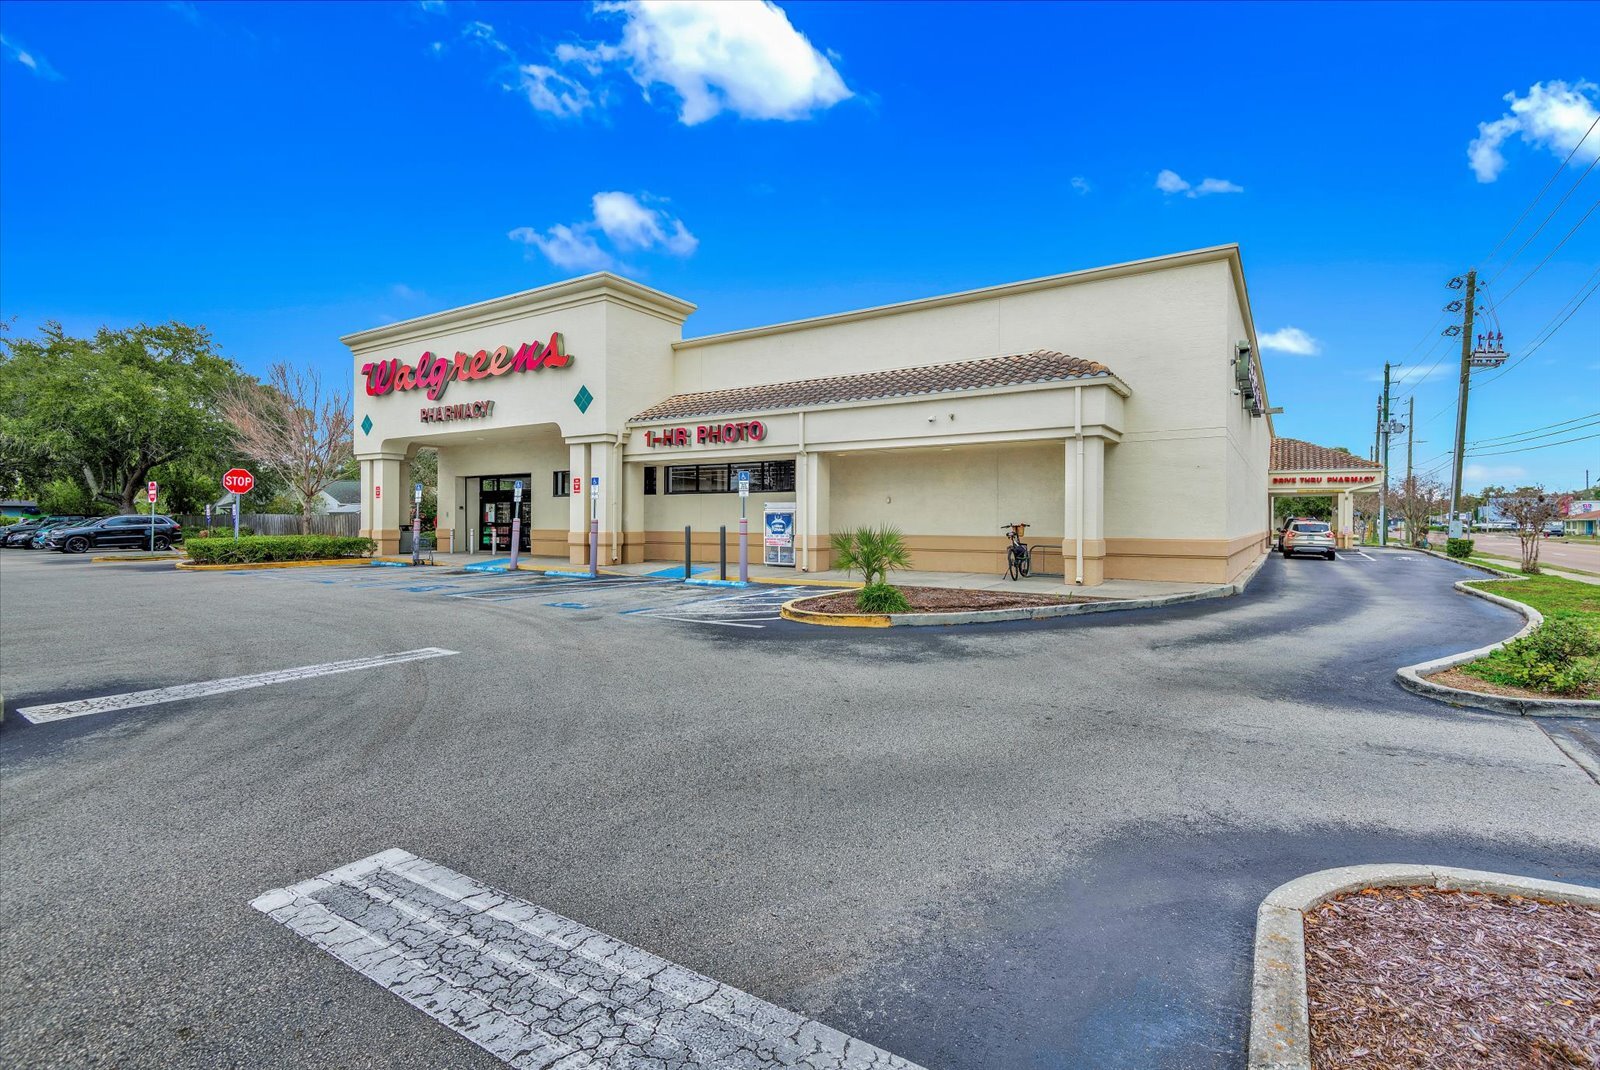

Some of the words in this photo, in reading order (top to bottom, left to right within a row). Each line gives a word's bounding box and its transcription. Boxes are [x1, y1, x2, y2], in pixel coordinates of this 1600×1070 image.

[362, 332, 572, 400] Walgreens
[420, 400, 493, 423] PHARMACY
[645, 427, 689, 448] 1-HR
[697, 420, 765, 445] PHOTO
[225, 476, 252, 487] STOP
